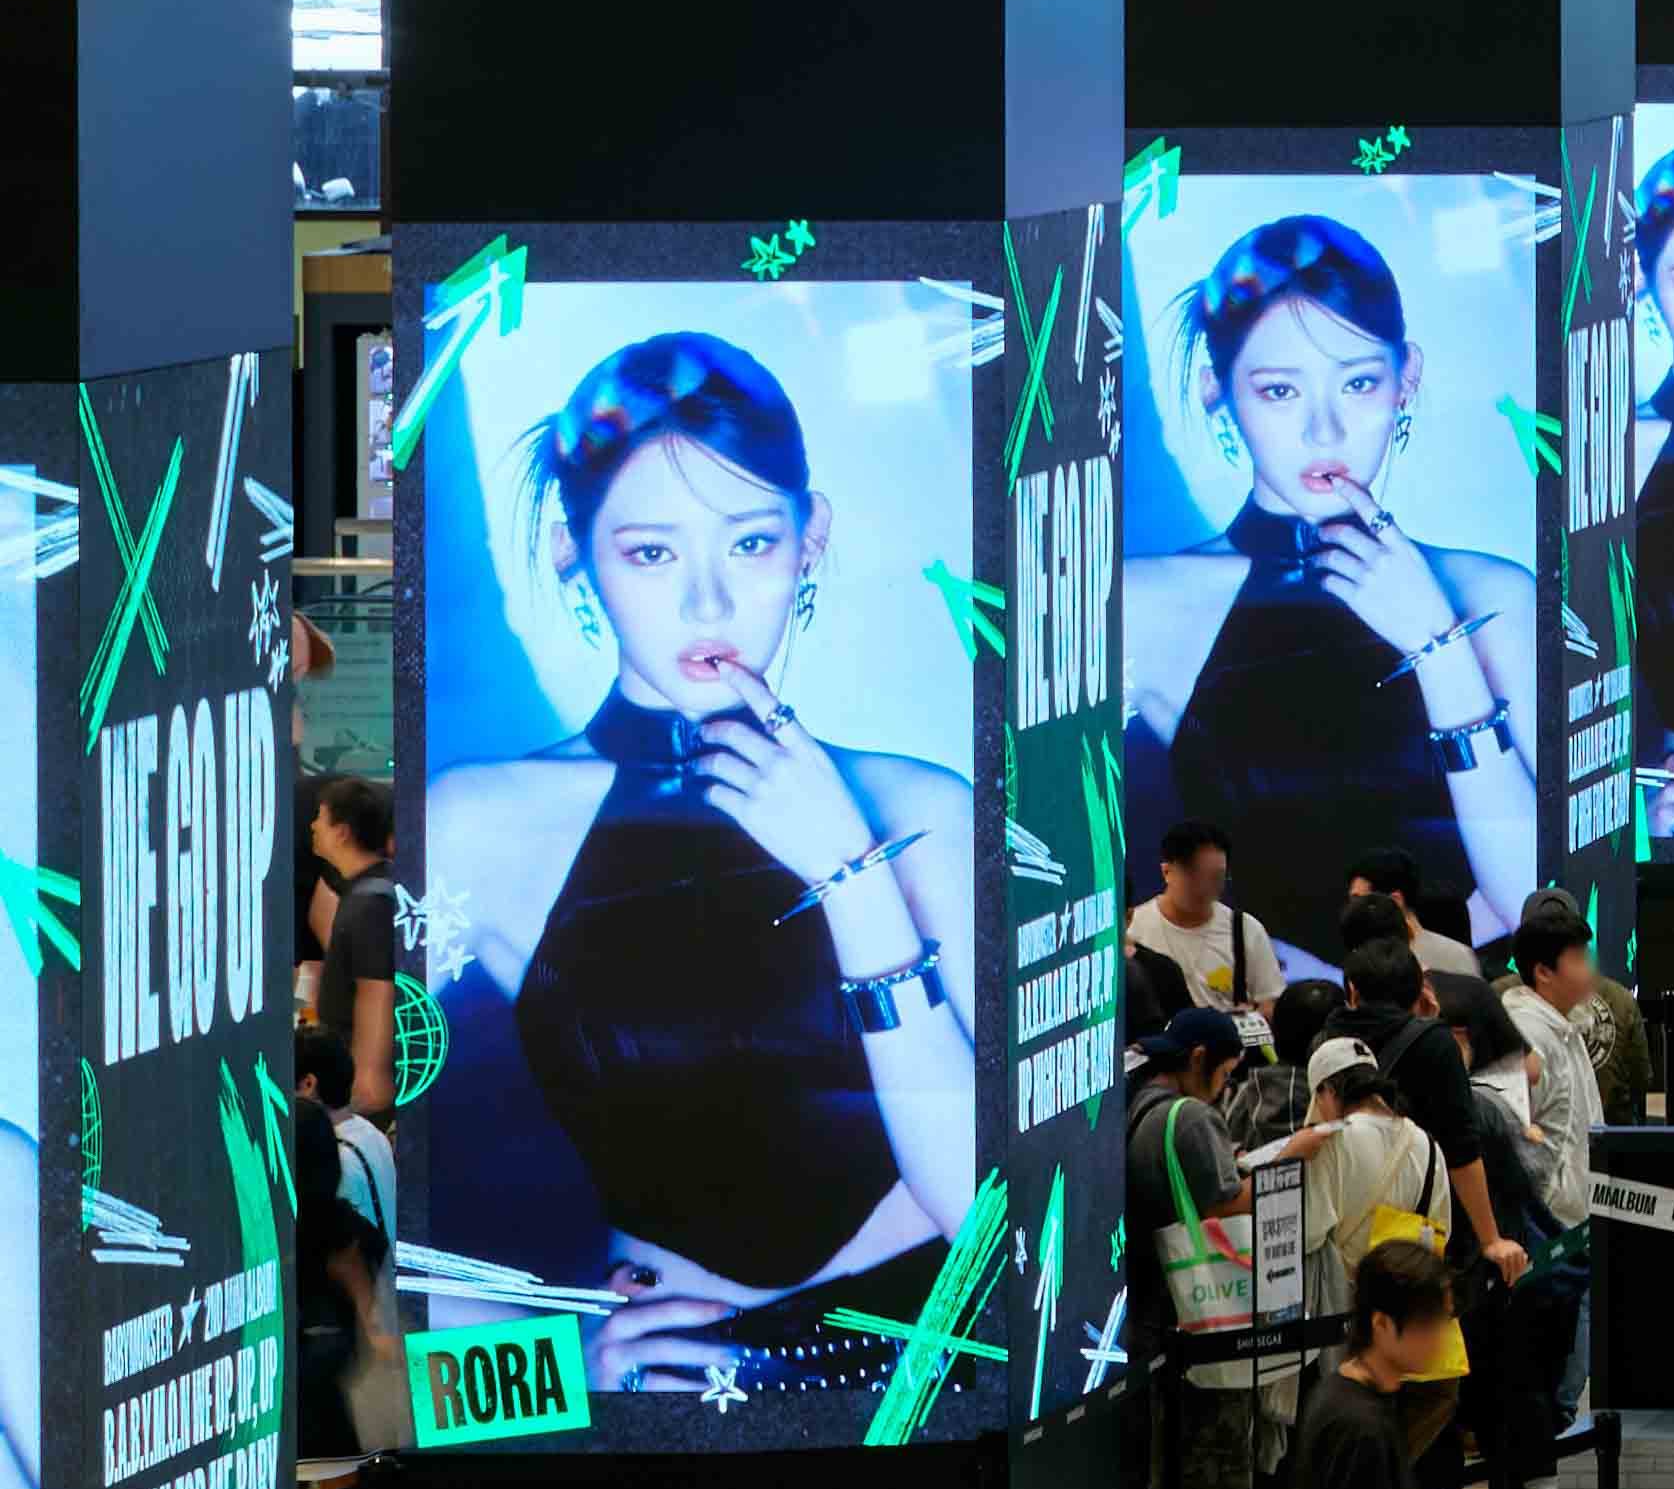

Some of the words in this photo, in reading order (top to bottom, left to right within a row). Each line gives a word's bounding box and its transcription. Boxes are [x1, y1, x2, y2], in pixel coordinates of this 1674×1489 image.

[1016, 470, 1049, 732] WE
[1052, 460, 1081, 720] GO
[1084, 454, 1114, 709] UP
[100, 712, 160, 1067] WE
[166, 696, 217, 1044] GO
[224, 685, 276, 1024] UP
[104, 1303, 173, 1387] BABYMONSTER
[1192, 1279, 1249, 1305] OLIVE
[104, 1372, 191, 1489] B.A.B.Y.M.O.N
[192, 1362, 213, 1445] WE
[214, 1353, 236, 1440] UP,
[237, 1344, 258, 1428] UP,
[259, 1334, 279, 1415] UP
[427, 1336, 568, 1432] RORA
